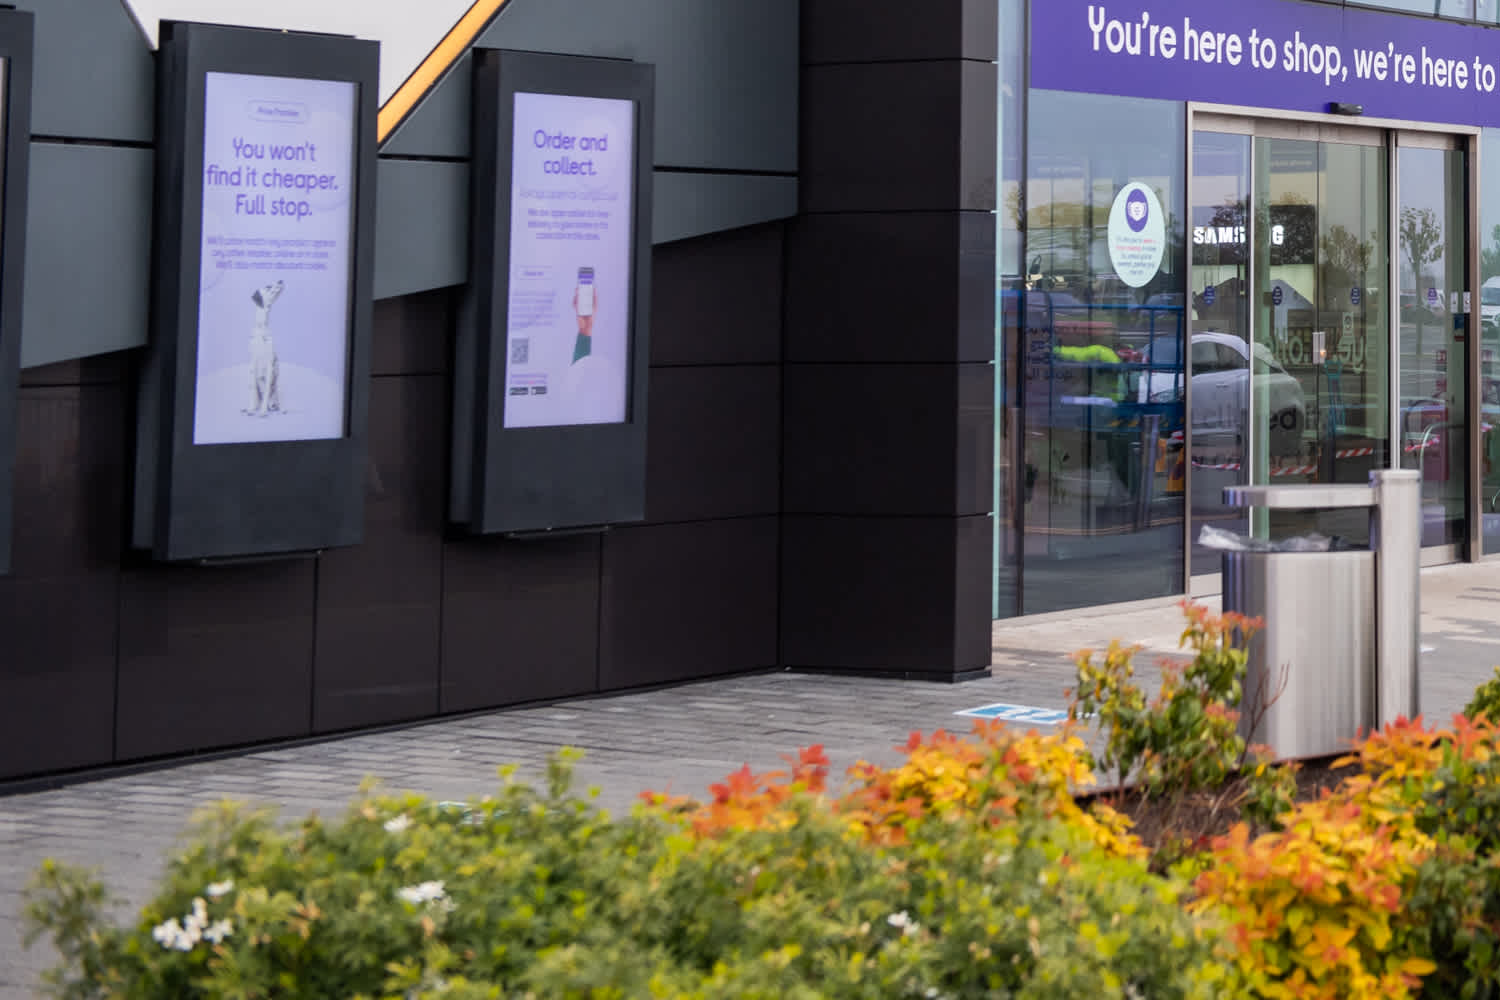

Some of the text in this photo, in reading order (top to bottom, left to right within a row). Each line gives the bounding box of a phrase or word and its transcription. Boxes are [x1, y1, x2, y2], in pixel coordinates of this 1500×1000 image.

[1088, 5, 1177, 59] You're
[1184, 17, 1242, 65] here
[1249, 28, 1276, 69] to
[1283, 31, 1348, 86] shop,
[1354, 42, 1416, 84] we're
[1422, 46, 1468, 89] here
[1473, 56, 1496, 92] to
[232, 137, 317, 162] You won't
[533, 129, 609, 151] Order and
[543, 156, 598, 176] collect.
[207, 164, 339, 194] find it cheaper.
[235, 194, 313, 222] Full stop.
[1193, 225, 1285, 245] SAMSG
